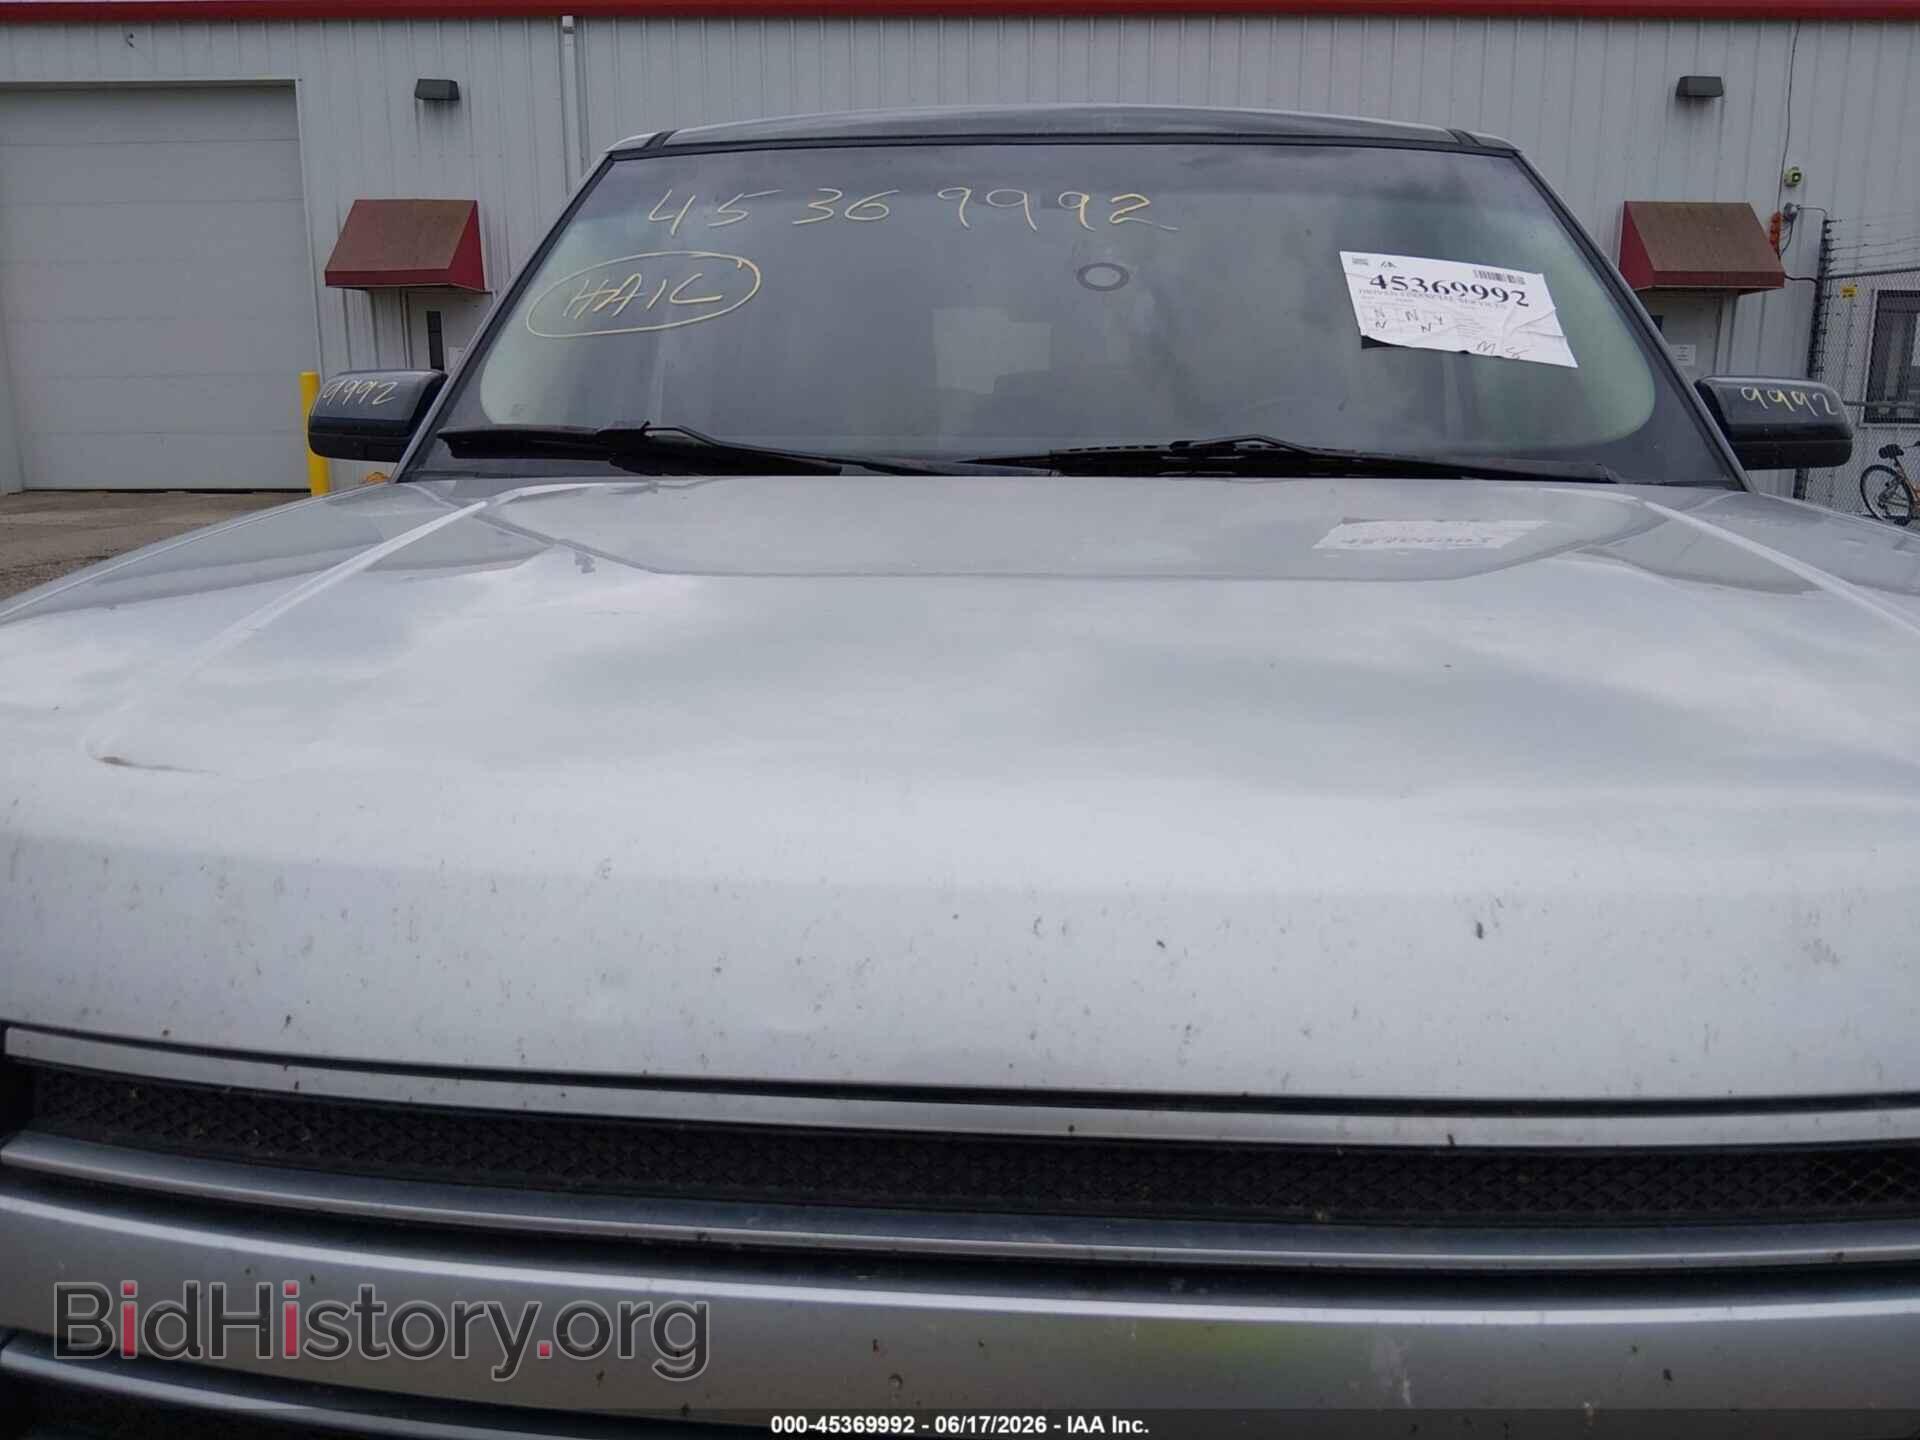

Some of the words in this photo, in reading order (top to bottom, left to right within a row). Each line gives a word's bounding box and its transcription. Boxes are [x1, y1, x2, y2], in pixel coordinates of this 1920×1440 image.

[1369, 274, 1530, 308] 45369992
[323, 379, 399, 406] 9992
[1740, 386, 1839, 417] 9992
